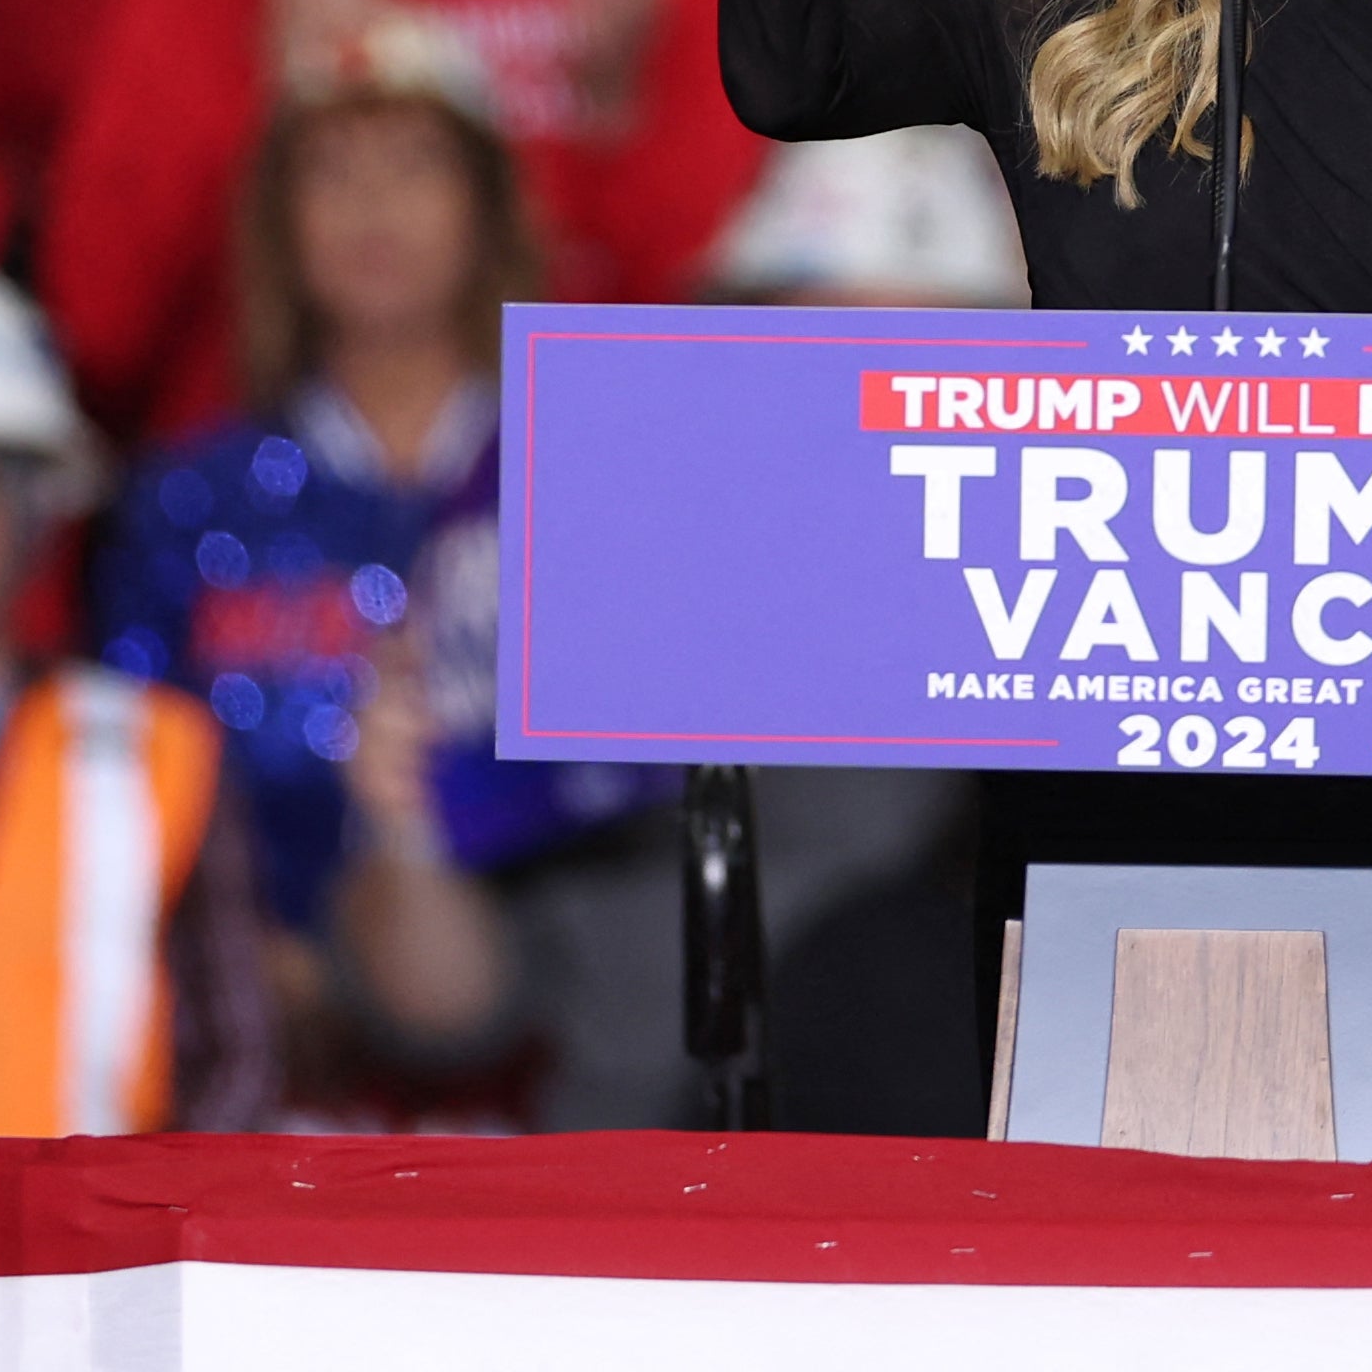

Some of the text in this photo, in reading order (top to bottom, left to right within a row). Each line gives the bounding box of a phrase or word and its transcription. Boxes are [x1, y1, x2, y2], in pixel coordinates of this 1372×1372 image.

[890, 375, 1141, 430] TRUMP
[1160, 380, 1336, 434] WILL
[926, 671, 1036, 700] MAKE
[1047, 673, 1225, 703] AMERICA
[1236, 675, 1365, 705] GREAT
[1116, 713, 1321, 770] 2024
